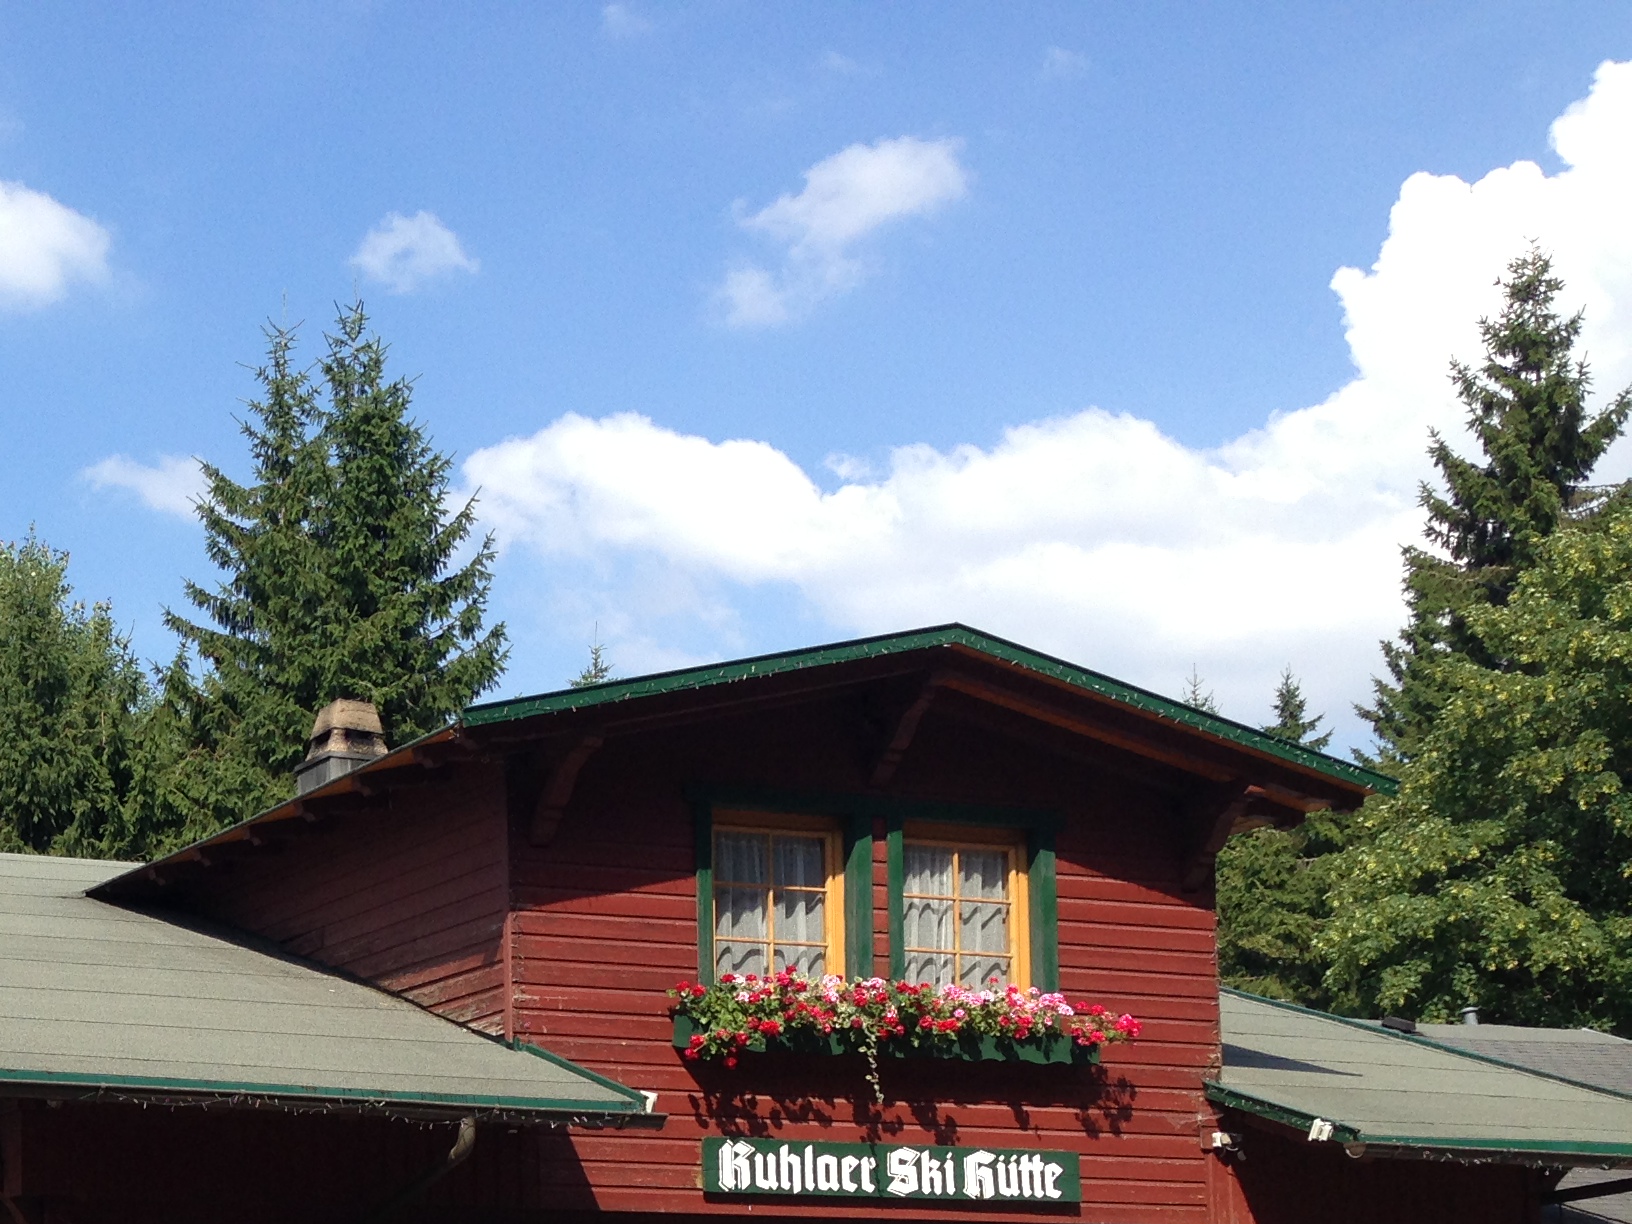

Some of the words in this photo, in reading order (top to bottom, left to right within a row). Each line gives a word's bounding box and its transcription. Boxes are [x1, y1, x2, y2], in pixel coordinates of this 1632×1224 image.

[718, 1139, 878, 1194] Ruhlaer
[886, 1146, 956, 1197] Ski
[962, 1150, 1065, 1200] Hütte
